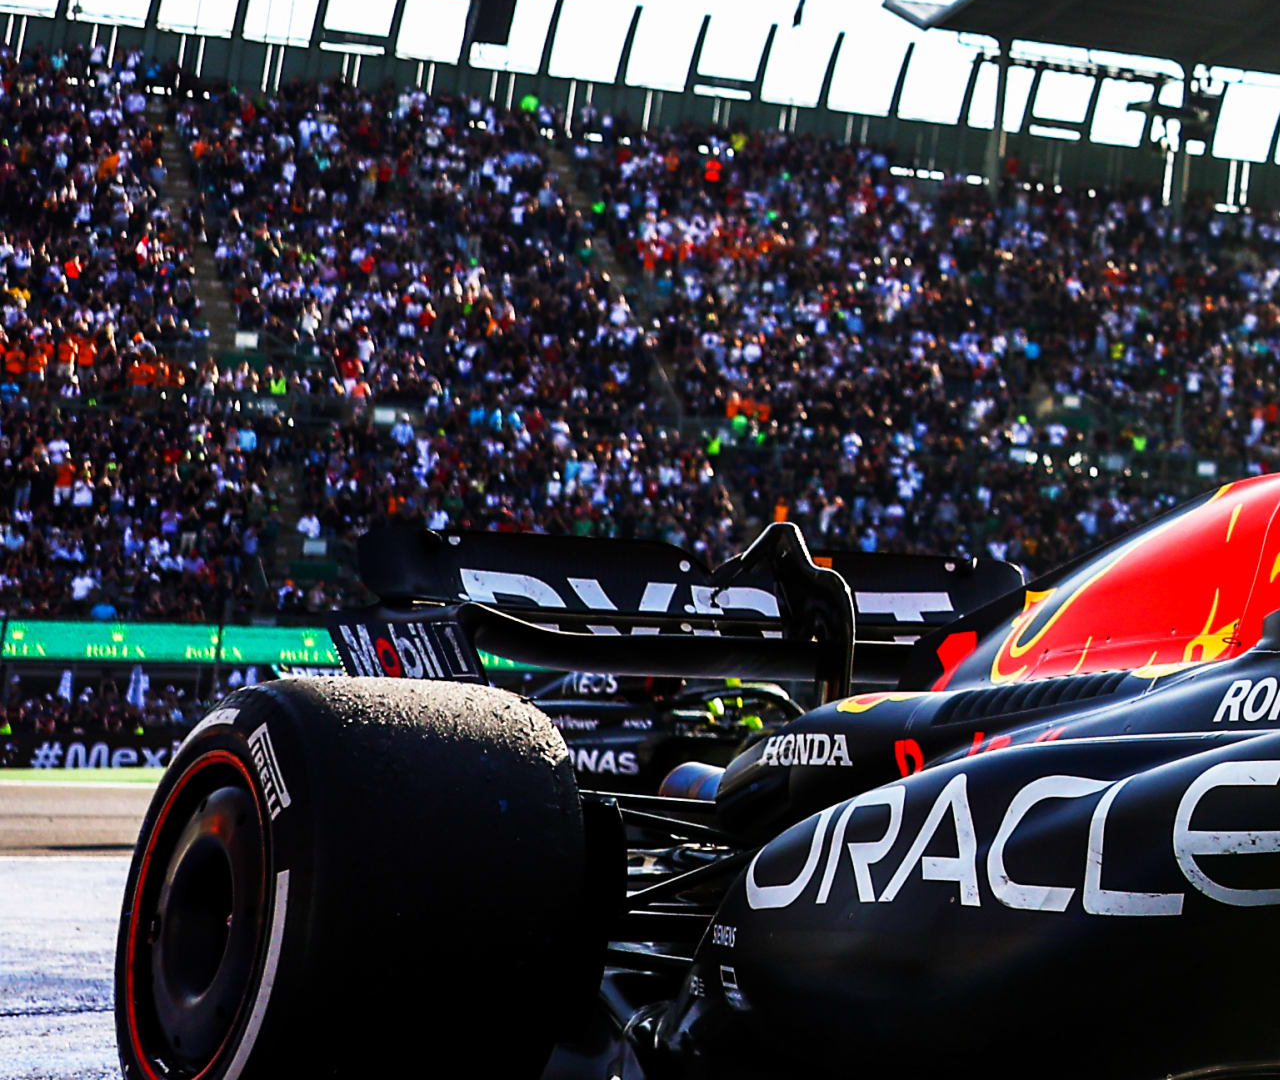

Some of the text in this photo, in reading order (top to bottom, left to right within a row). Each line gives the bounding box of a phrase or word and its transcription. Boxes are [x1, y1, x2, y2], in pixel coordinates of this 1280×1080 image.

[338, 622, 446, 678] Mobil
[247, 721, 292, 821] PIRELLI
[758, 733, 853, 767] HONDA
